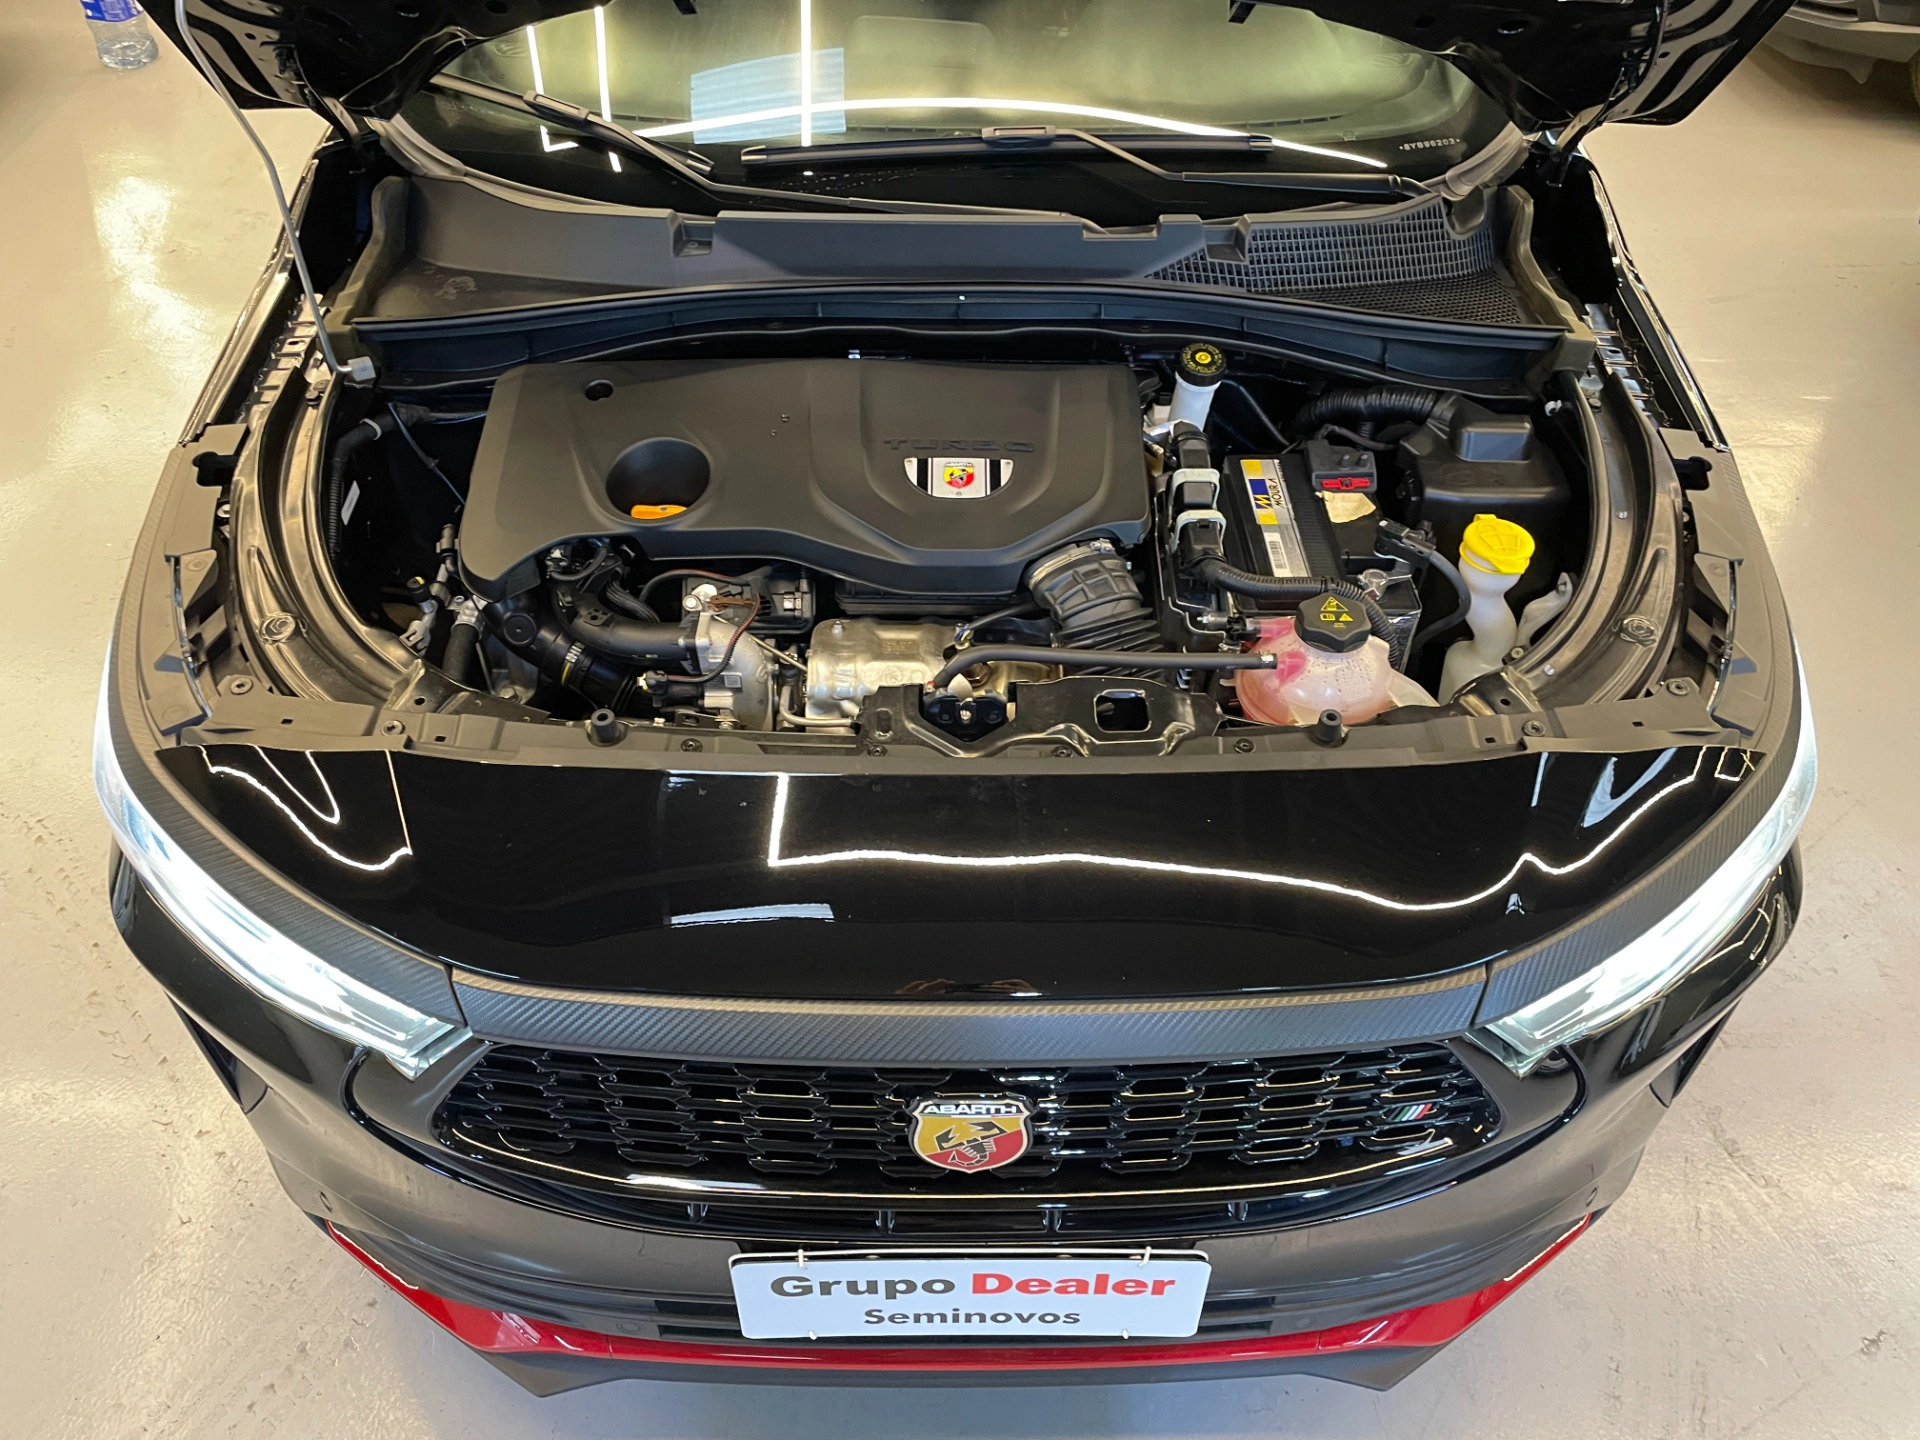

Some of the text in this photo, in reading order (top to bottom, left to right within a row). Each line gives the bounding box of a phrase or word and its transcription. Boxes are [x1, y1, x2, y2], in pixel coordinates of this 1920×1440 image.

[883, 438, 1036, 454] TURBO
[1268, 478, 1285, 510] MOURA
[923, 1104, 1017, 1115] ABARTH
[770, 1273, 1176, 1300] Grupo Dealer
[864, 1307, 1081, 1325] Seminovos
